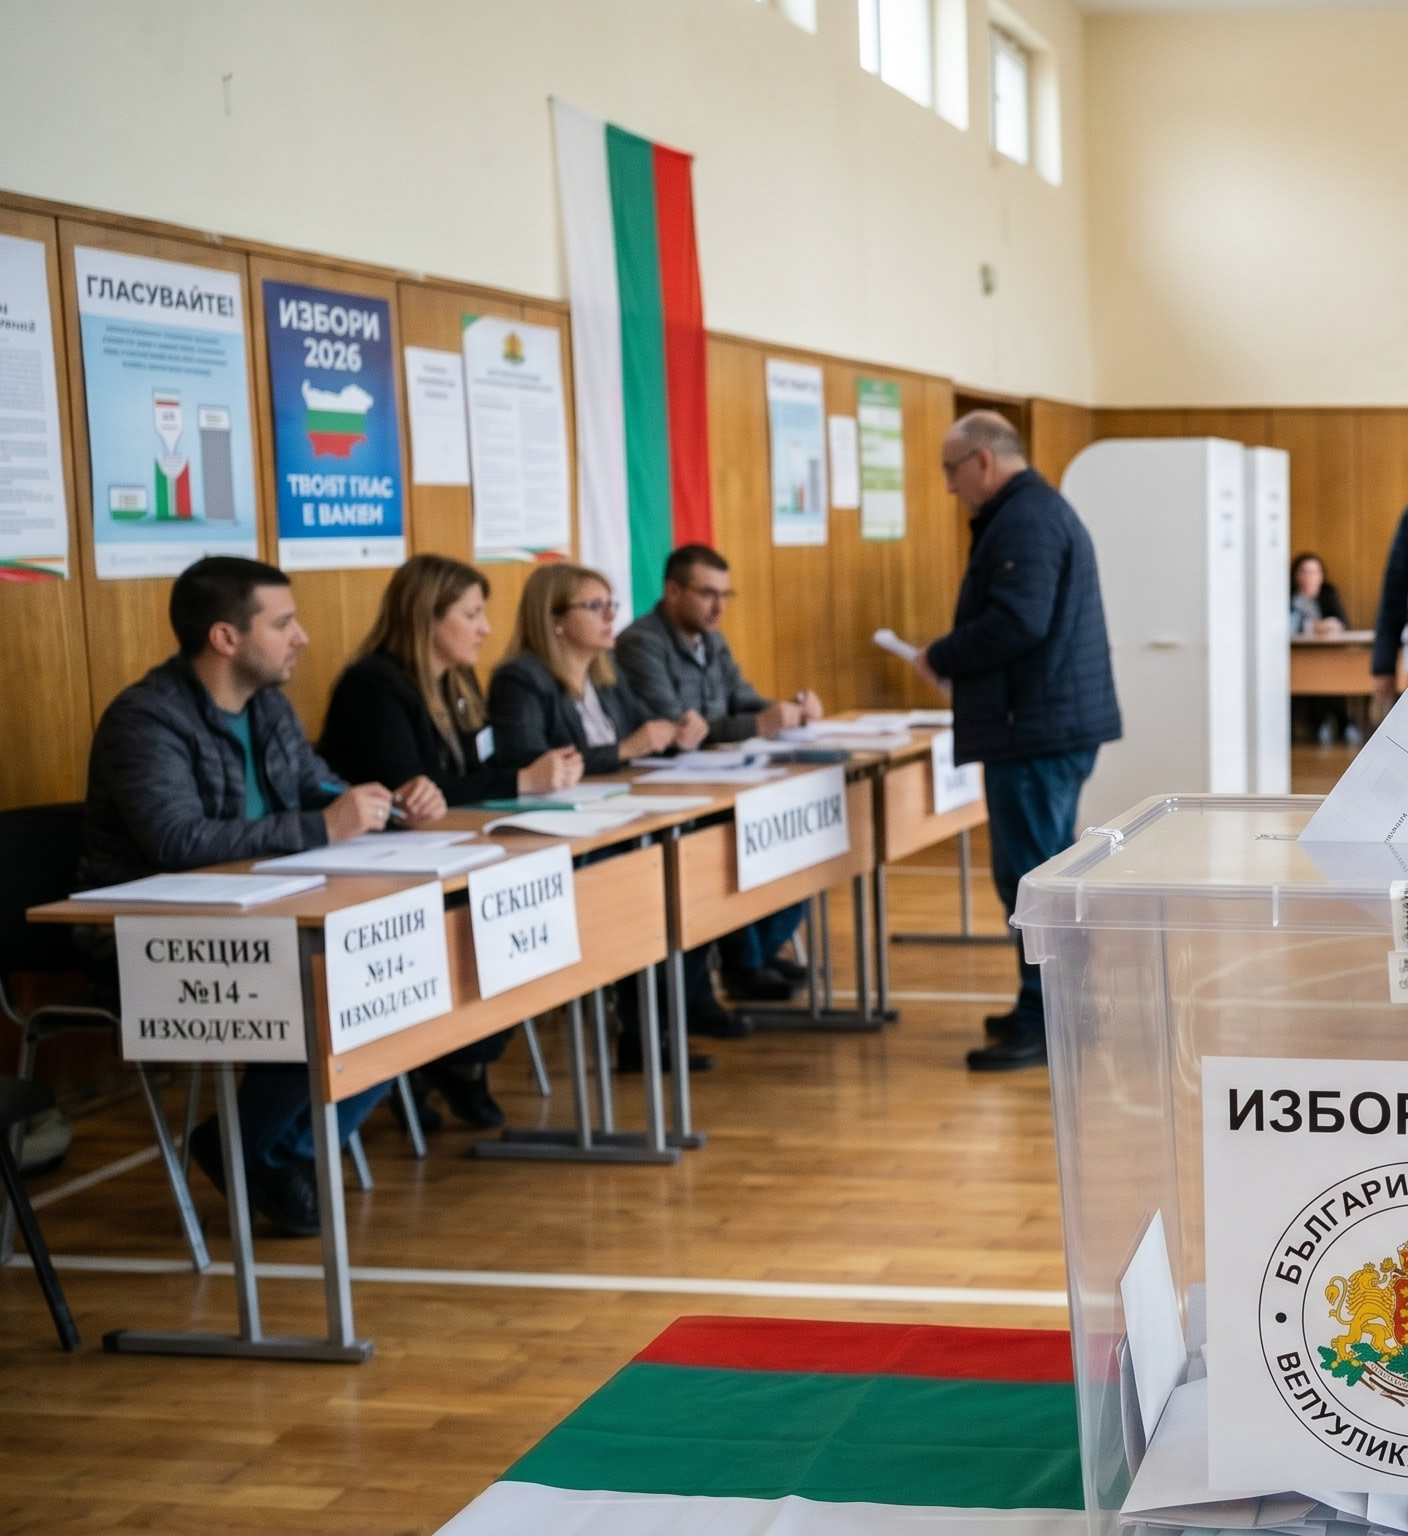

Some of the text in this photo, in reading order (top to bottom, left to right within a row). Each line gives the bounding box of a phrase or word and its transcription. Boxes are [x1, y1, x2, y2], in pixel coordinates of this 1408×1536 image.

[86, 274, 235, 318] ГЛАСУВАЙТЕ!
[279, 297, 380, 342] ИЗБОРИ
[303, 336, 363, 373] 2026
[743, 792, 842, 857] КОМИСИЯ
[481, 872, 564, 923] СЕКЦИЯ
[145, 937, 271, 967] СЕКЦИЯ
[343, 908, 426, 955] СЕКЦИЯ
[508, 921, 549, 960] №14
[365, 953, 404, 988] №14
[178, 979, 240, 1004] №14
[339, 976, 440, 1032] ИЗХОД/EXIT
[138, 1017, 290, 1044] ИЗХОД/EXIT
